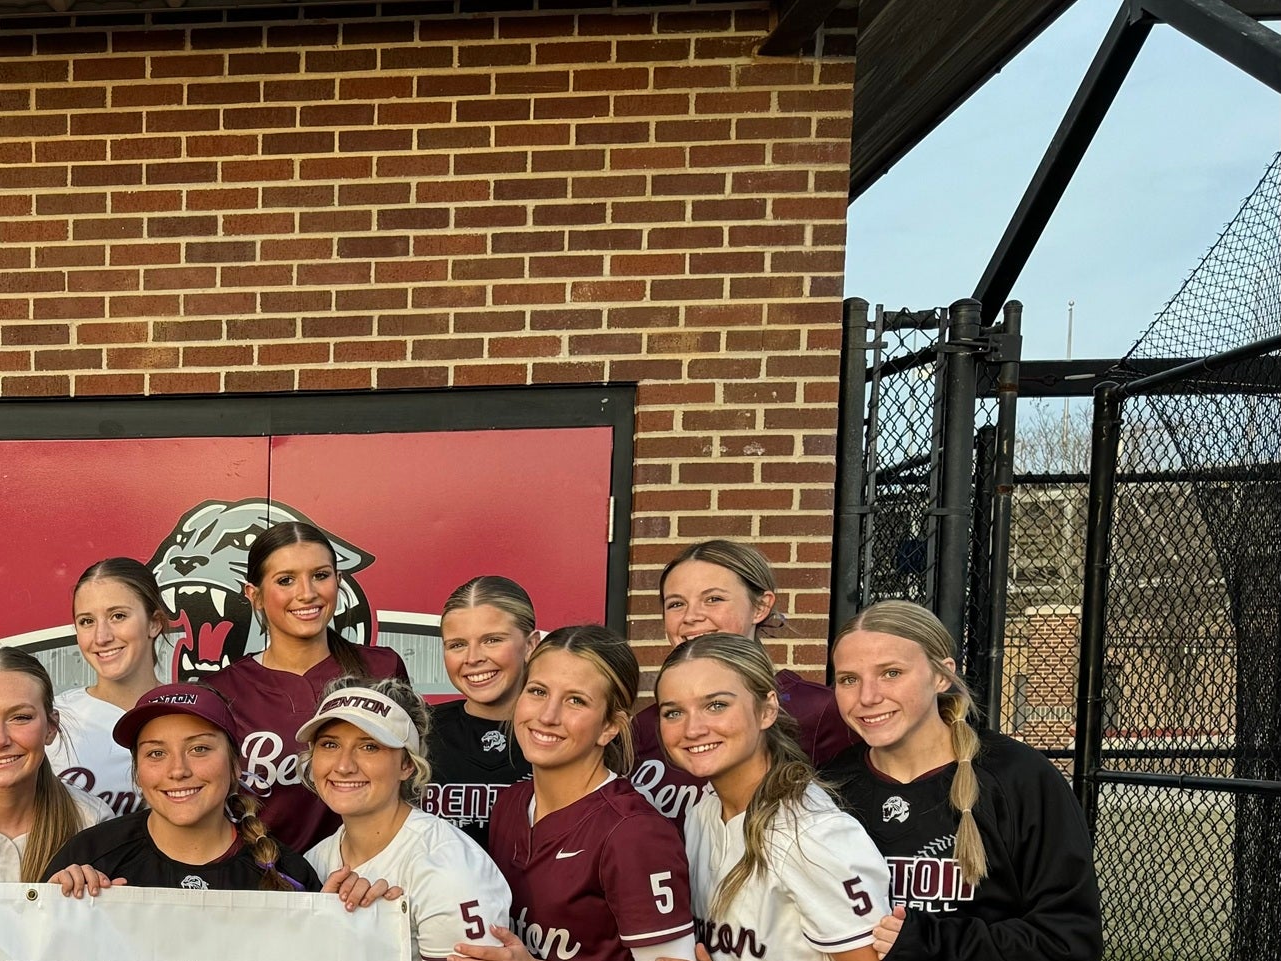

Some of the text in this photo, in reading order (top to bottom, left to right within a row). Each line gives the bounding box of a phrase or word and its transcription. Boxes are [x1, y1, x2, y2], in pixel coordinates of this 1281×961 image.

[631, 759, 707, 818] Ben
[650, 871, 674, 914] 5
[843, 876, 873, 917] 5
[460, 900, 485, 940] 5
[509, 907, 581, 960] ton
